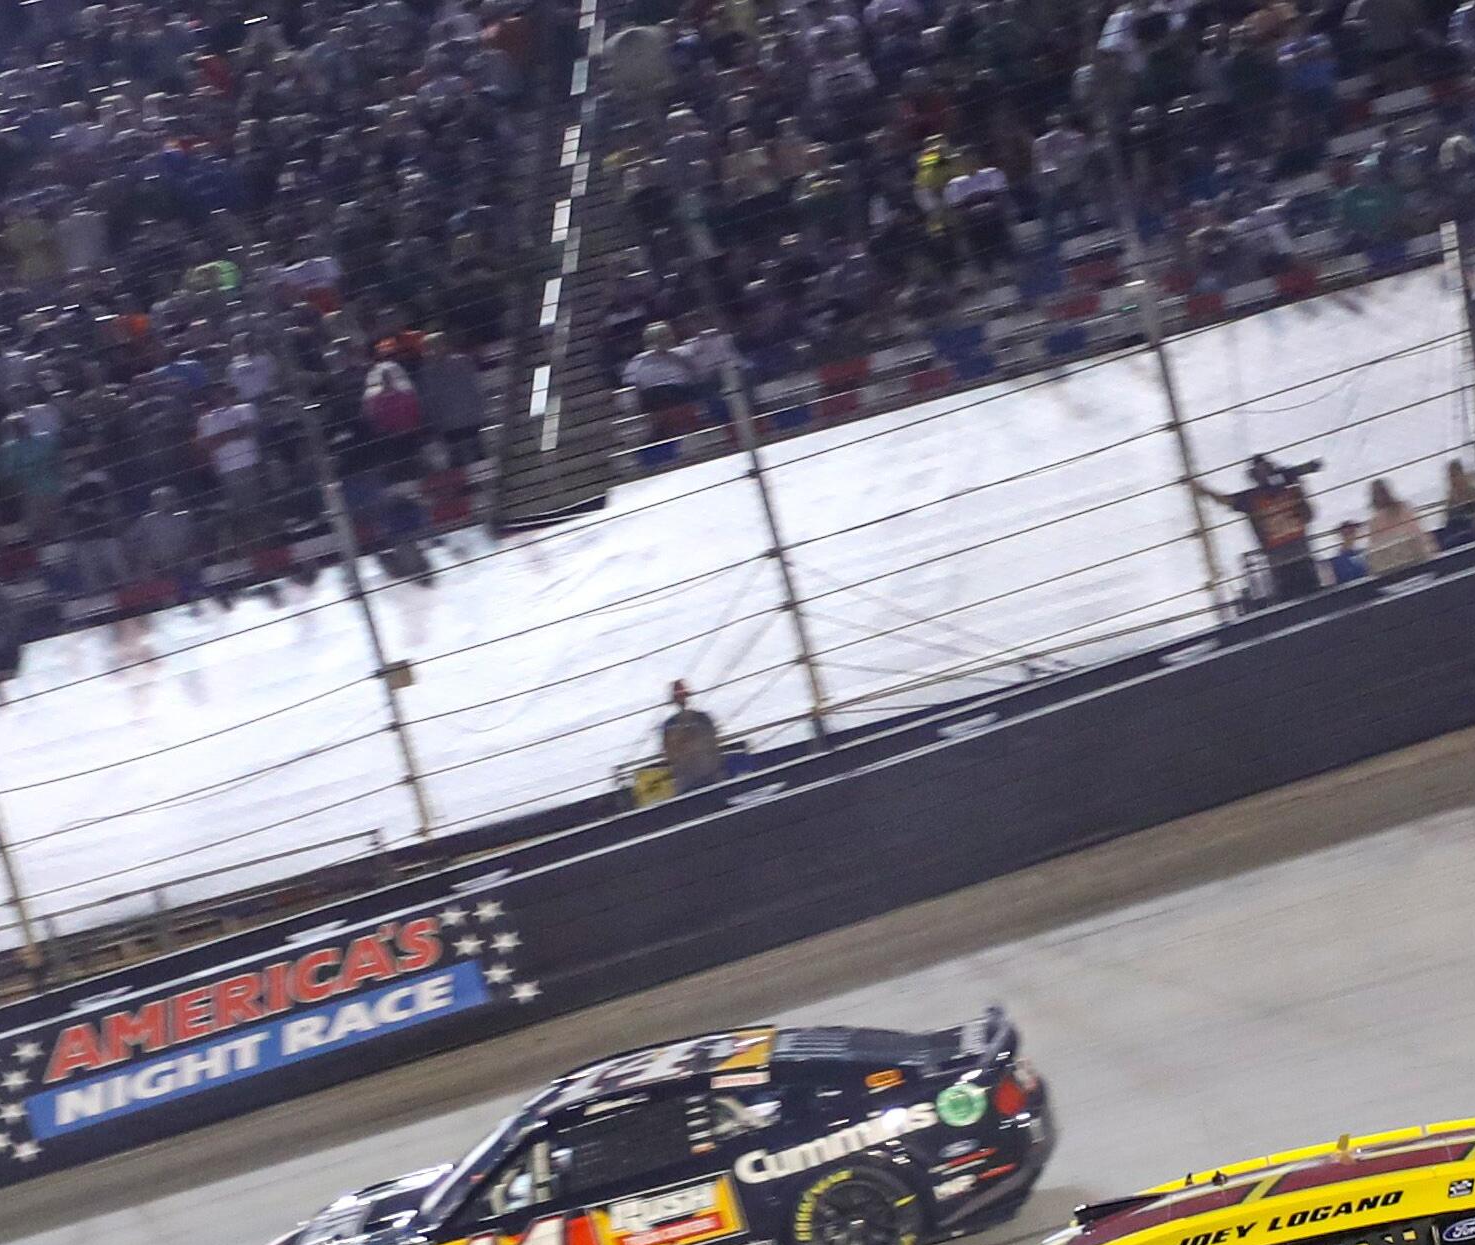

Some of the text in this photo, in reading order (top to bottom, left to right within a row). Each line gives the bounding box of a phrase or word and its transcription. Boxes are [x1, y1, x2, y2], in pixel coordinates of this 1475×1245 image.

[43, 918, 443, 1082] AMERICA'S
[54, 973, 456, 1125] NIGHT RACE
[1267, 1190, 1403, 1232] LOGANO
